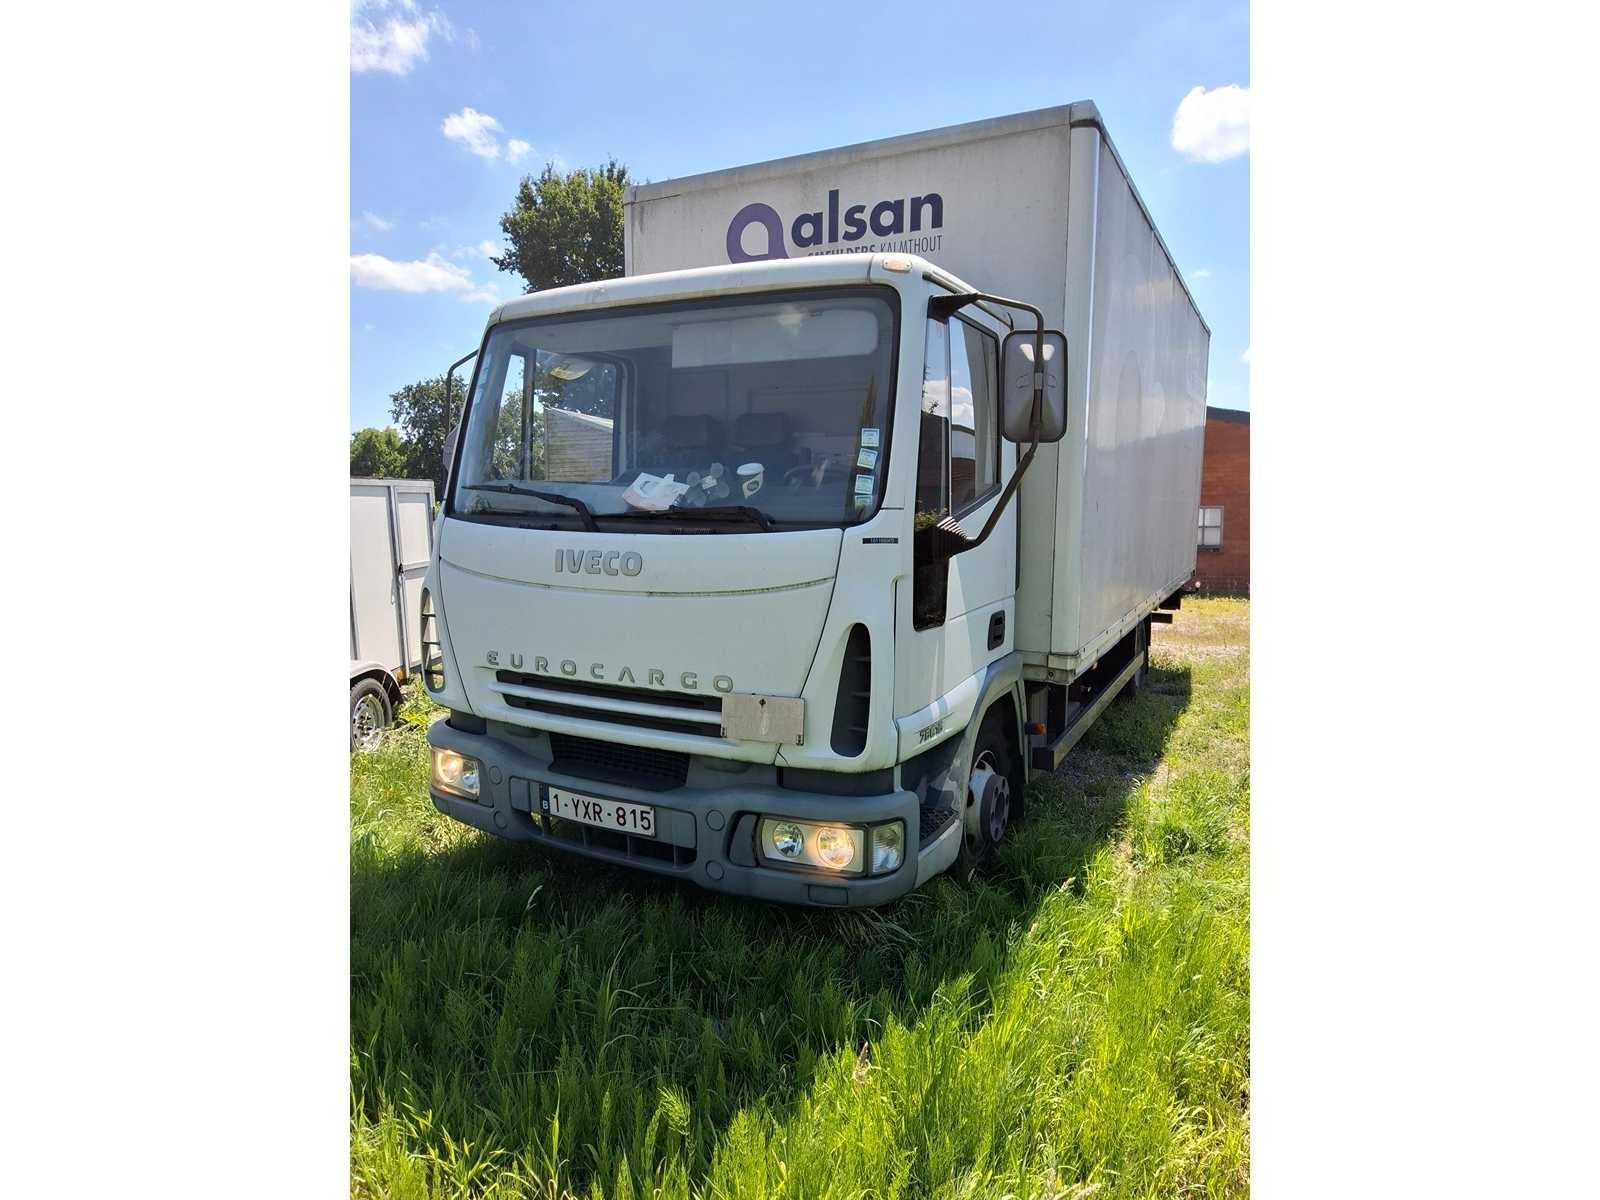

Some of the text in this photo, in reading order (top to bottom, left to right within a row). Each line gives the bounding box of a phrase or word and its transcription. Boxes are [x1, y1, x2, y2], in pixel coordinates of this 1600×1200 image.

[791, 189, 944, 248] alsan
[554, 549, 643, 577] IVECO
[486, 650, 734, 693] EUROCARGO
